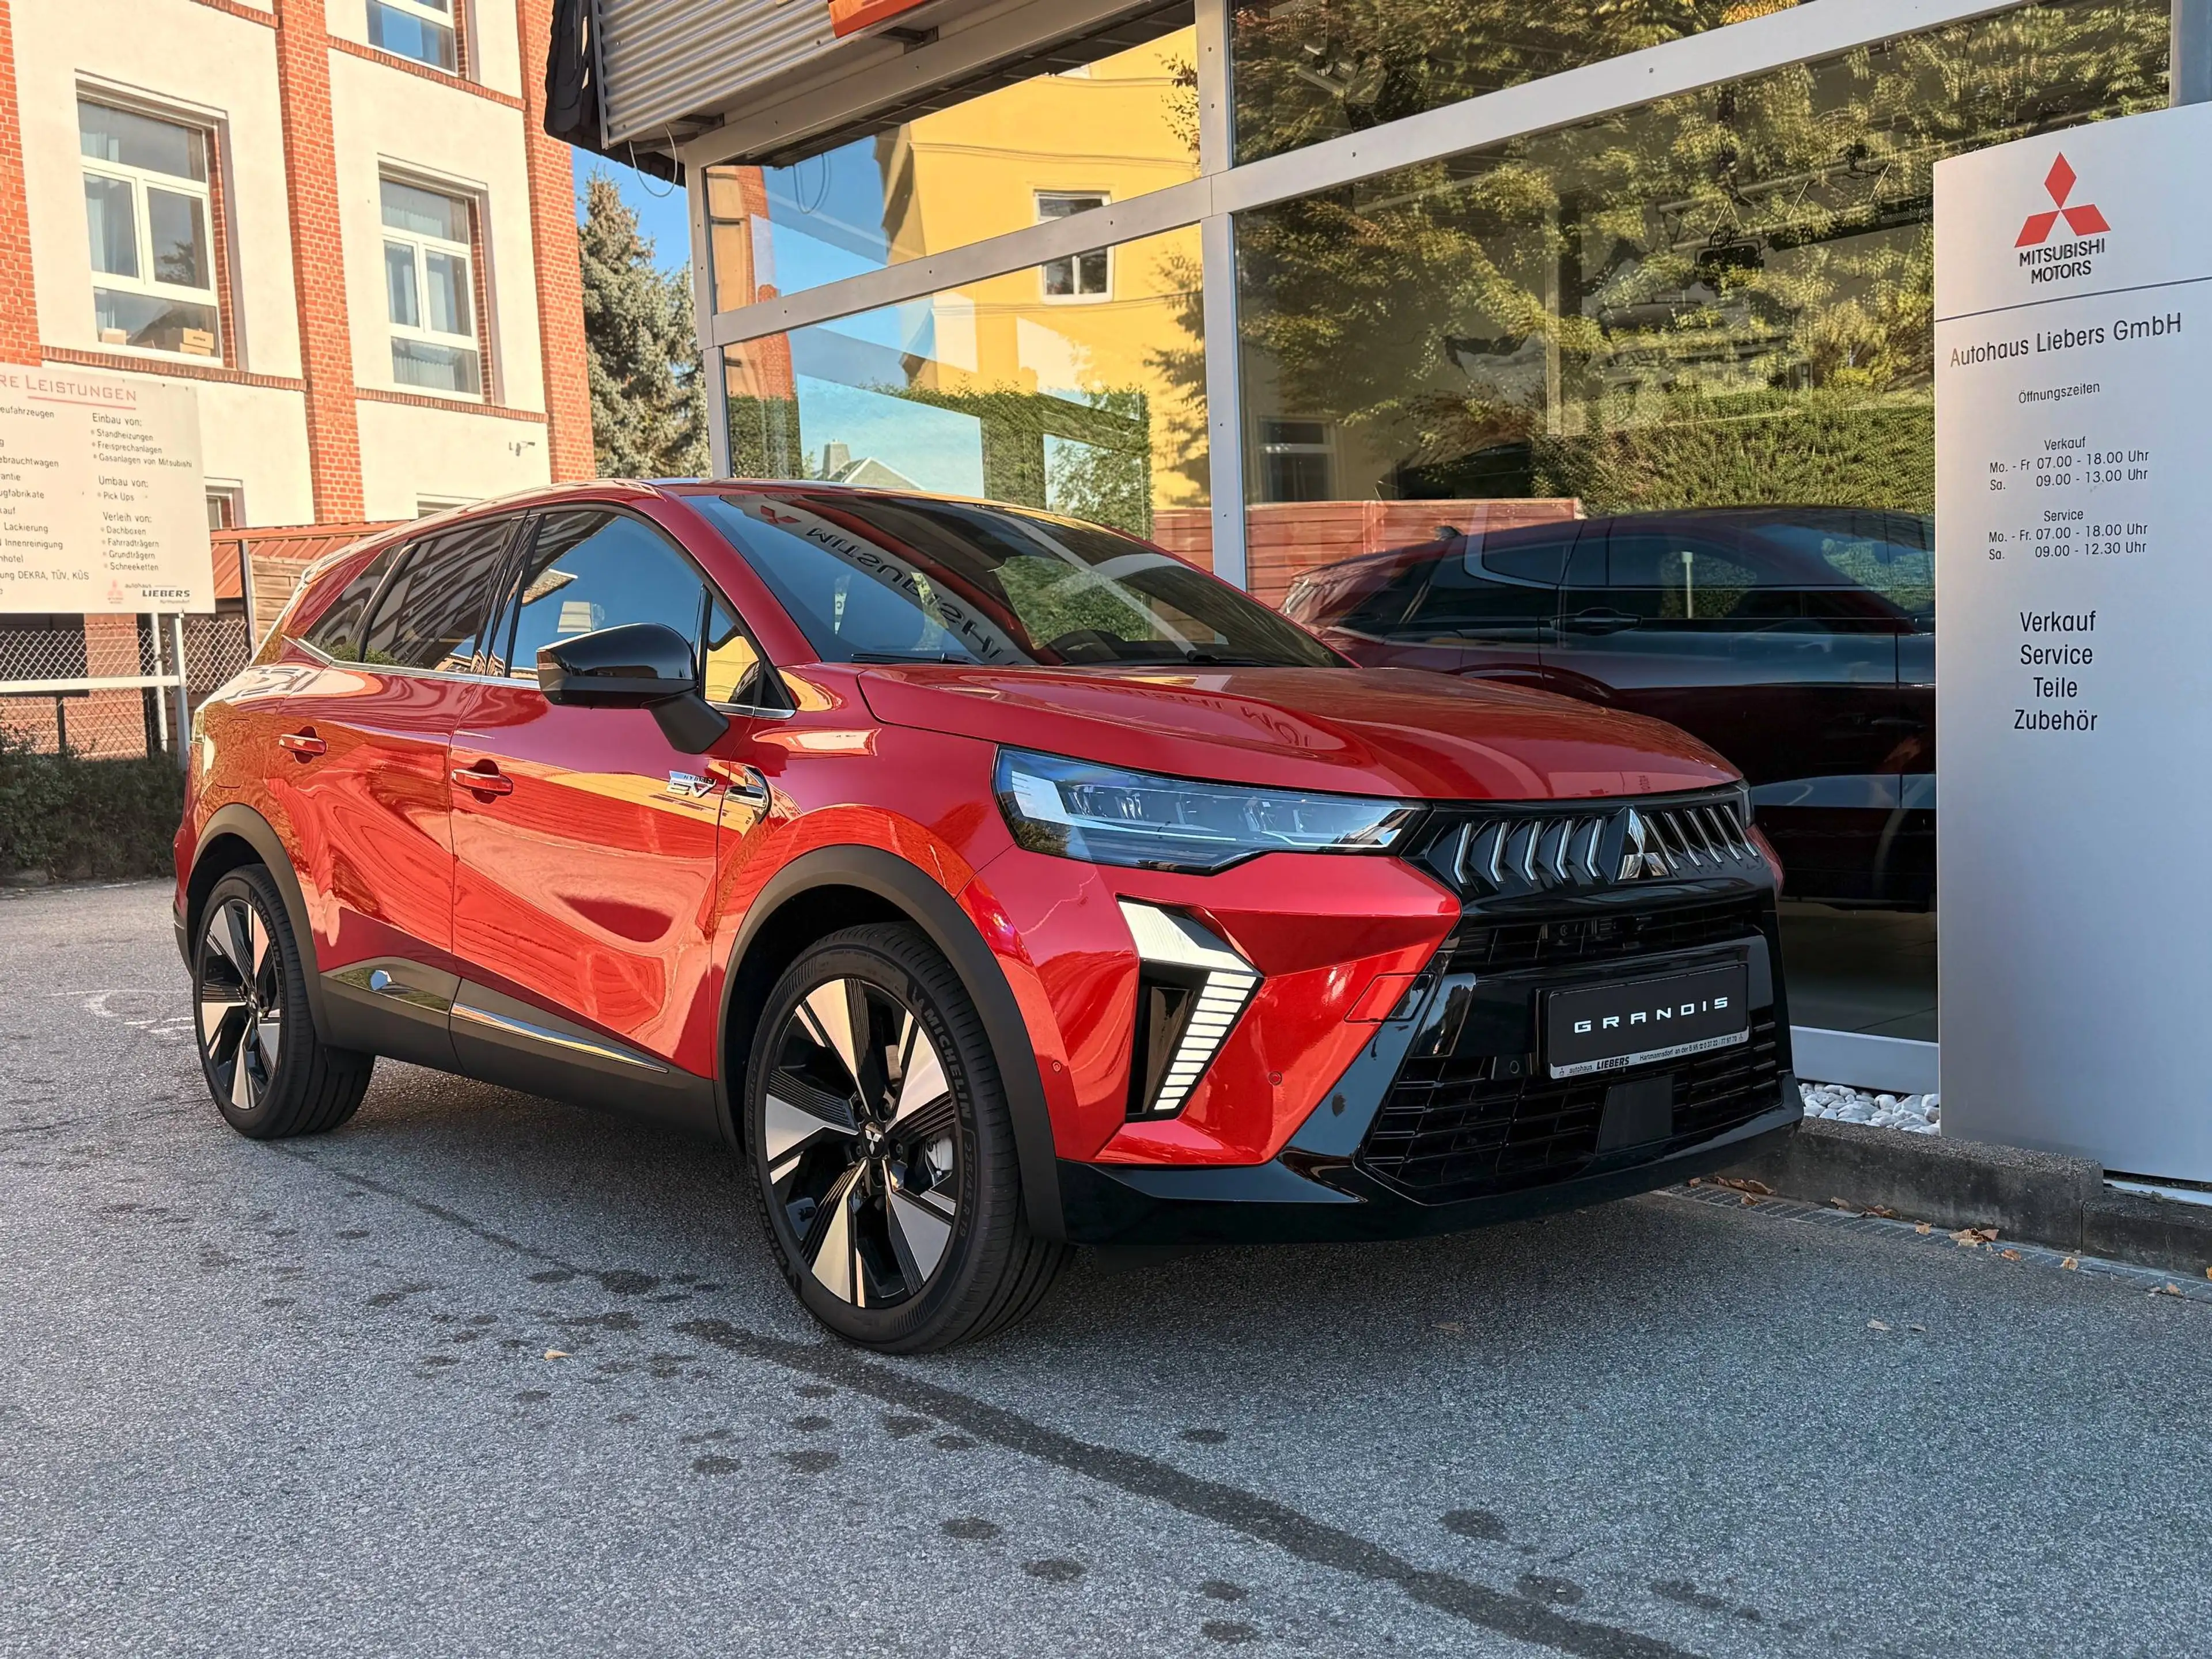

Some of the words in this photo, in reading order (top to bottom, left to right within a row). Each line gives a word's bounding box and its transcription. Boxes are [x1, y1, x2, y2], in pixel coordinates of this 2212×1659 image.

[2020, 238, 2105, 267] MITSUBISHI
[2032, 261, 2091, 284] MOTORS
[1950, 339, 2028, 367] Autohaus
[2037, 327, 2104, 352] Liebers
[2113, 313, 2180, 340] GmbH
[25, 375, 137, 402] LEISTUNGEN
[2019, 382, 2100, 404] Öffnungszeiten
[92, 412, 121, 425] Einbau
[125, 418, 142, 426] von:
[97, 429, 153, 442] Standheizungen
[98, 441, 162, 454] Freisprechanlagen
[2044, 437, 2086, 450] Verkauf
[99, 453, 141, 465] Gasanlagen
[158, 459, 192, 467] Mitsubishi
[1990, 462, 2008, 474] Mo.
[2037, 455, 2072, 469] 07.00
[2086, 451, 2123, 466] 18.00
[2128, 450, 2149, 463] Uhr
[99, 475, 128, 486] Umbau
[1990, 480, 2006, 490] Sa.
[2036, 474, 2071, 488] 09.00
[2085, 469, 2122, 484] 13.00
[2128, 468, 2147, 481] Uhr
[103, 491, 118, 499] Pick
[120, 492, 134, 501] Ups
[103, 512, 131, 521] Verleih
[2044, 509, 2083, 522] Service
[4, 522, 48, 533] Lackierung
[107, 525, 146, 535] Dachboxen
[1989, 532, 2007, 543] Mo.
[2020, 529, 2031, 540] Fr.
[2036, 528, 2071, 540] 07.00
[2086, 524, 2122, 537] 18.00
[2127, 524, 2148, 535] Uhr
[5, 539, 63, 550] Innenreinigung
[108, 538, 159, 548] Fahrradträgern
[109, 550, 155, 560] Grundträgern
[1989, 550, 2005, 560] Sa.
[2035, 545, 2069, 558] 09.00
[2085, 543, 2120, 555] 12.30
[2126, 542, 2146, 554] Uhr
[110, 562, 159, 571] Schneeketten
[2020, 610, 2096, 632] Verkauf
[2020, 644, 2093, 665] Service
[2033, 676, 2077, 698] Teile
[2014, 709, 2097, 731] Zubehör
[1574, 997, 1728, 1033] GRANDIS
[924, 1009, 971, 1119] MICHELIN
[1596, 1056, 1630, 1070] LIEBERS
